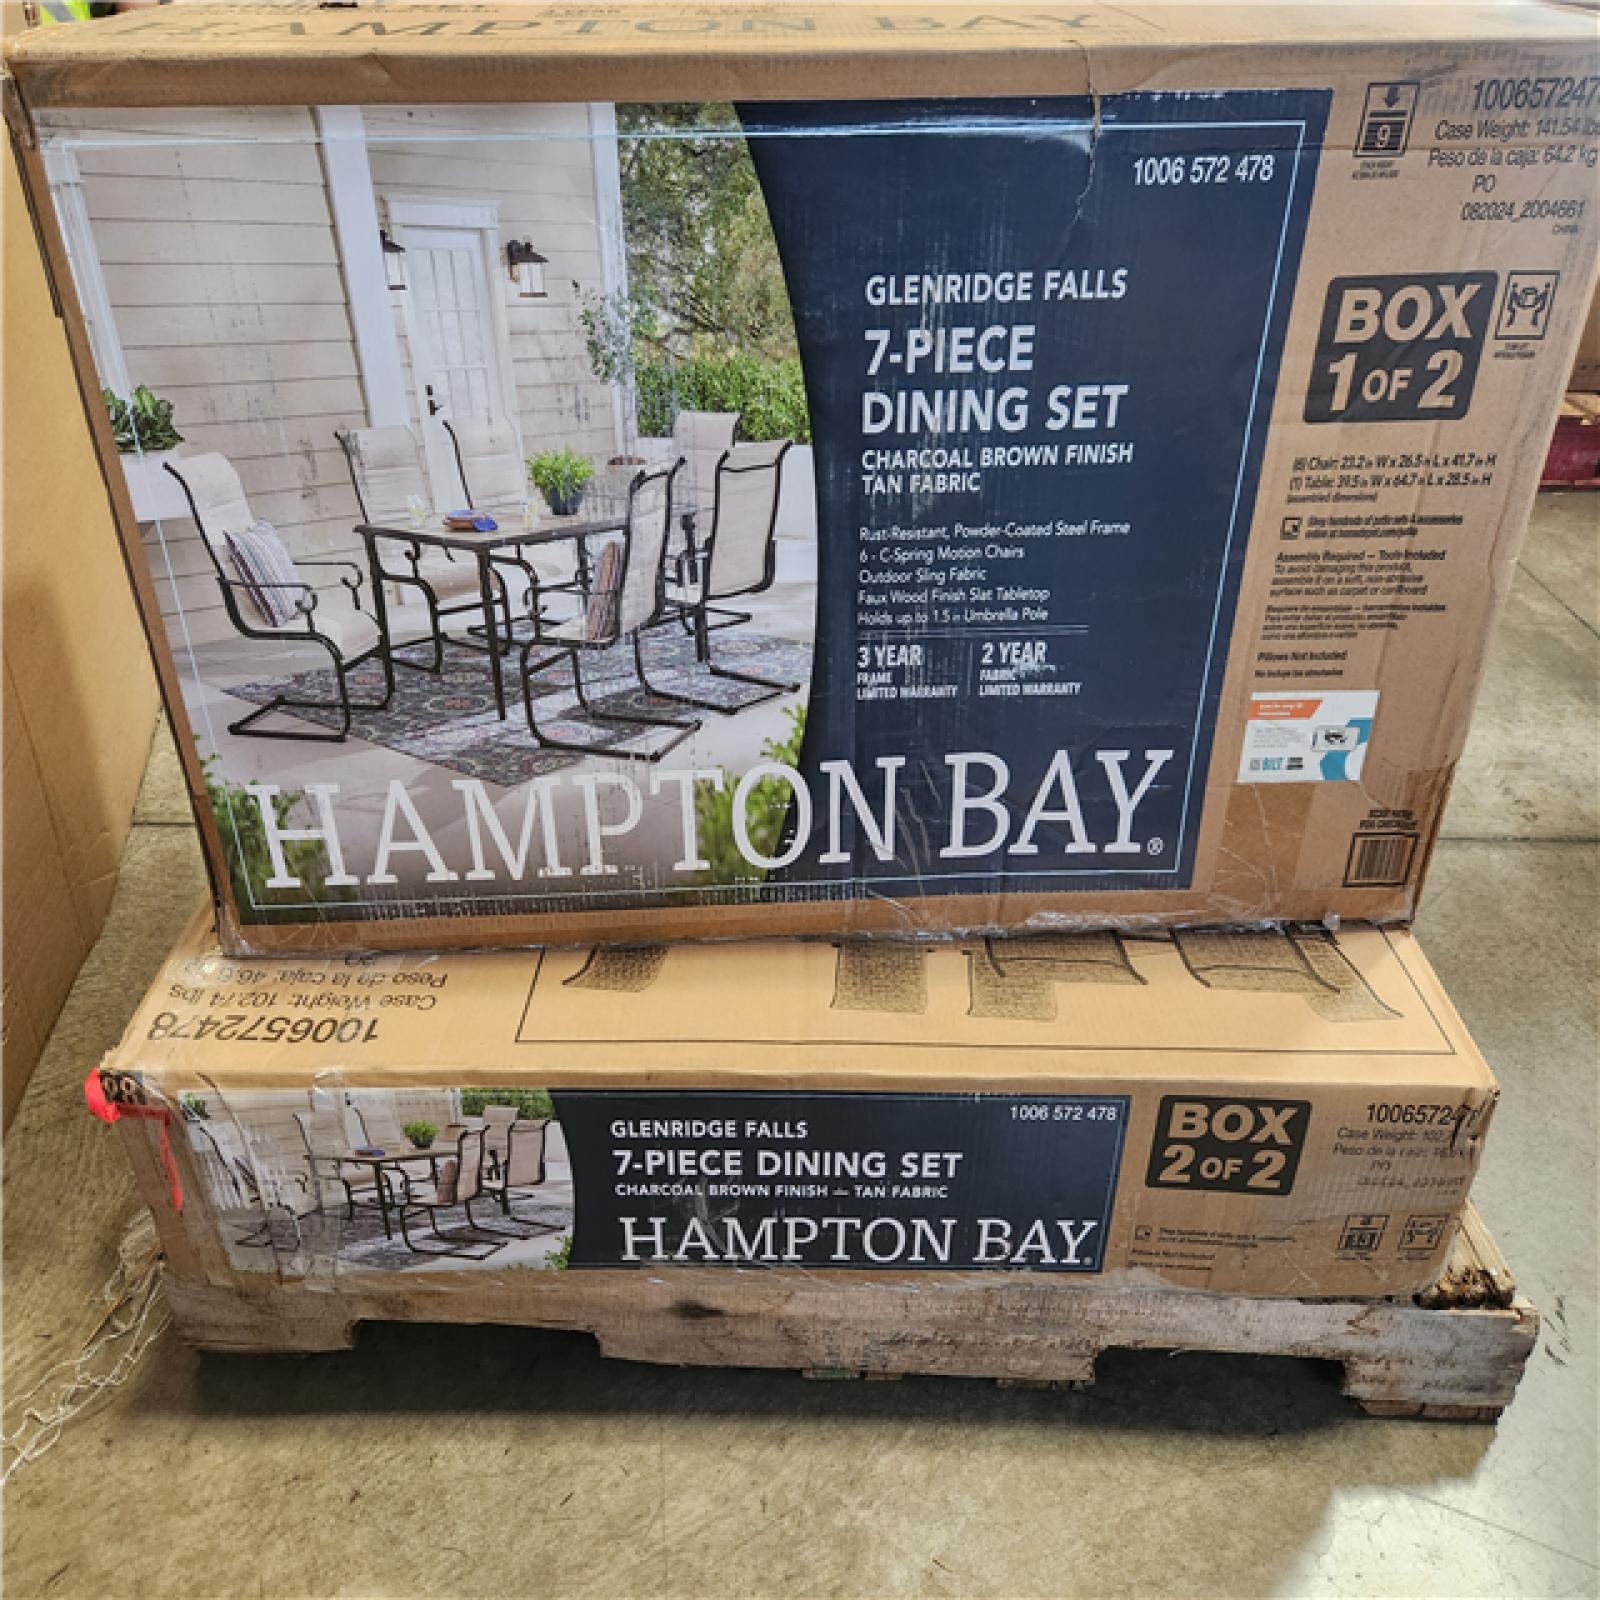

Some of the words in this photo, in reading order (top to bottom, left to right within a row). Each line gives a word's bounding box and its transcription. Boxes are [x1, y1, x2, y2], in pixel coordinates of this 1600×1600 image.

[1472, 77, 1600, 111] 100657247
[1375, 124, 1391, 149] 9
[1435, 119, 1472, 140] Case
[1427, 146, 1465, 168] Peso
[1467, 147, 1488, 166] de
[1490, 146, 1502, 166] la
[1579, 145, 1598, 168] kg
[1134, 157, 1185, 186] 1006
[1190, 155, 1230, 184] 572
[1235, 154, 1275, 182] 478
[1472, 174, 1496, 193] PO
[865, 271, 1033, 306] GLENRIDGE
[1044, 267, 1128, 301] FALLS
[1334, 284, 1481, 344] BOX
[864, 324, 1036, 375] 7-PIECE
[1328, 352, 1358, 412] 1
[1362, 368, 1413, 403] OF
[1417, 349, 1463, 409] 2
[862, 386, 1029, 434] DINING
[1044, 384, 1130, 431] SET
[861, 448, 973, 470] CHARCOAL
[979, 446, 1058, 469] BROWN
[1064, 442, 1133, 466] FINISH
[861, 473, 901, 495] TAN
[909, 471, 981, 494] FABRIC
[1089, 519, 1130, 536] Frame
[880, 546, 933, 565] C-Spring
[937, 544, 981, 561] Motion
[859, 569, 912, 584] Outdoor
[915, 567, 945, 586] Sling
[950, 565, 987, 581] Fabric
[965, 607, 1018, 623] Umbrella
[1021, 606, 1049, 621] Pole
[857, 646, 870, 668] 3
[875, 644, 923, 666] YEAR
[981, 641, 995, 664] 2
[999, 640, 1048, 664] YEAR
[857, 686, 898, 700] LIMITED
[899, 684, 958, 698] WARRANTY
[979, 684, 1020, 697] LIMITED
[1022, 682, 1083, 696] WARRANTY
[245, 756, 905, 888] HAMPTON
[331, 971, 351, 988] la
[356, 971, 386, 988] de
[392, 971, 448, 988] Peso
[169, 984, 206, 1005] lbs
[287, 992, 371, 1010] Weight:
[380, 994, 438, 1010] Case
[148, 1012, 379, 1043] 1006572478
[1010, 1106, 1048, 1121] 1006
[1052, 1106, 1083, 1121] 572
[1087, 1106, 1116, 1121] 478
[1168, 1102, 1298, 1146] BOX
[611, 1119, 737, 1139] GLENRIDGE
[744, 1121, 808, 1139] FALLS
[612, 1149, 744, 1177] 7-PIECE
[756, 1149, 886, 1178] DINING
[901, 1152, 963, 1178] SET
[1159, 1145, 1197, 1183] 2
[1200, 1157, 1243, 1181] OF
[1247, 1150, 1286, 1188] 2
[614, 1184, 703, 1196] CHARCOAL
[709, 1184, 771, 1197] BROWN
[774, 1184, 828, 1197] FINISH
[854, 1185, 886, 1198] TAN
[892, 1185, 948, 1198] FABRIC
[619, 1216, 958, 1262] HAMPTON
